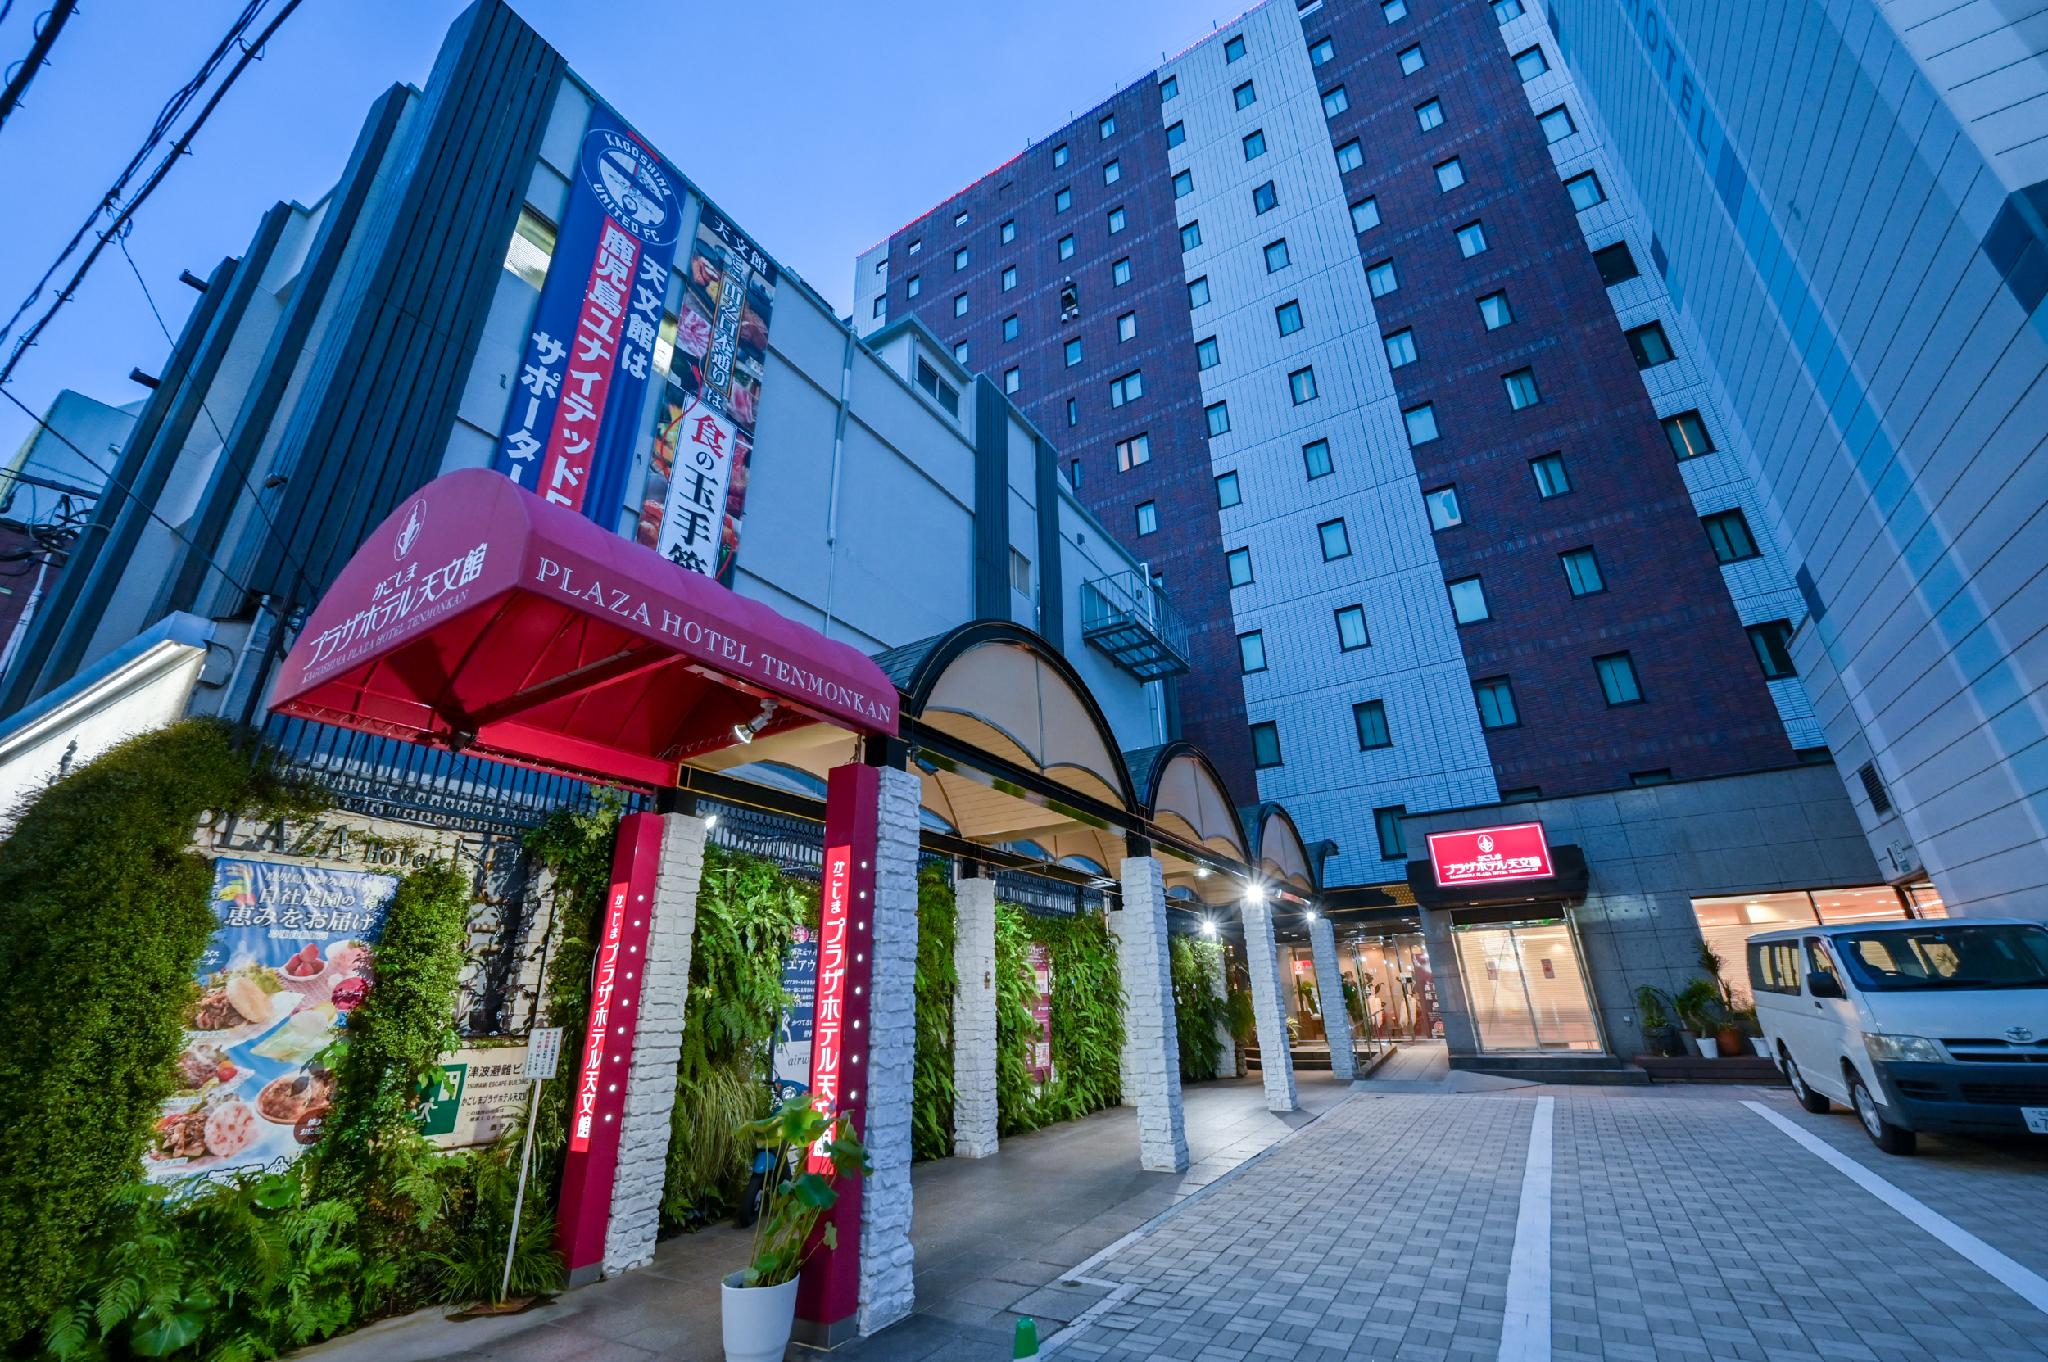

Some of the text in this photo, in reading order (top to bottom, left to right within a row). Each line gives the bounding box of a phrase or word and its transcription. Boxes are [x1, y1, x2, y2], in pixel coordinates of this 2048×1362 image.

[605, 133, 671, 196] KAGOSHIMA
[593, 183, 660, 242] UNITED FC
[713, 214, 768, 276] 天文館
[622, 253, 668, 380] 天文館は
[302, 542, 488, 671] プラザホテル天文館
[372, 562, 418, 602] かごしま
[535, 556, 892, 724] PLAZA HOTEL TENMONKAN
[197, 807, 350, 864] PLAZA
[468, 1062, 525, 1079] 津波避難ビ
